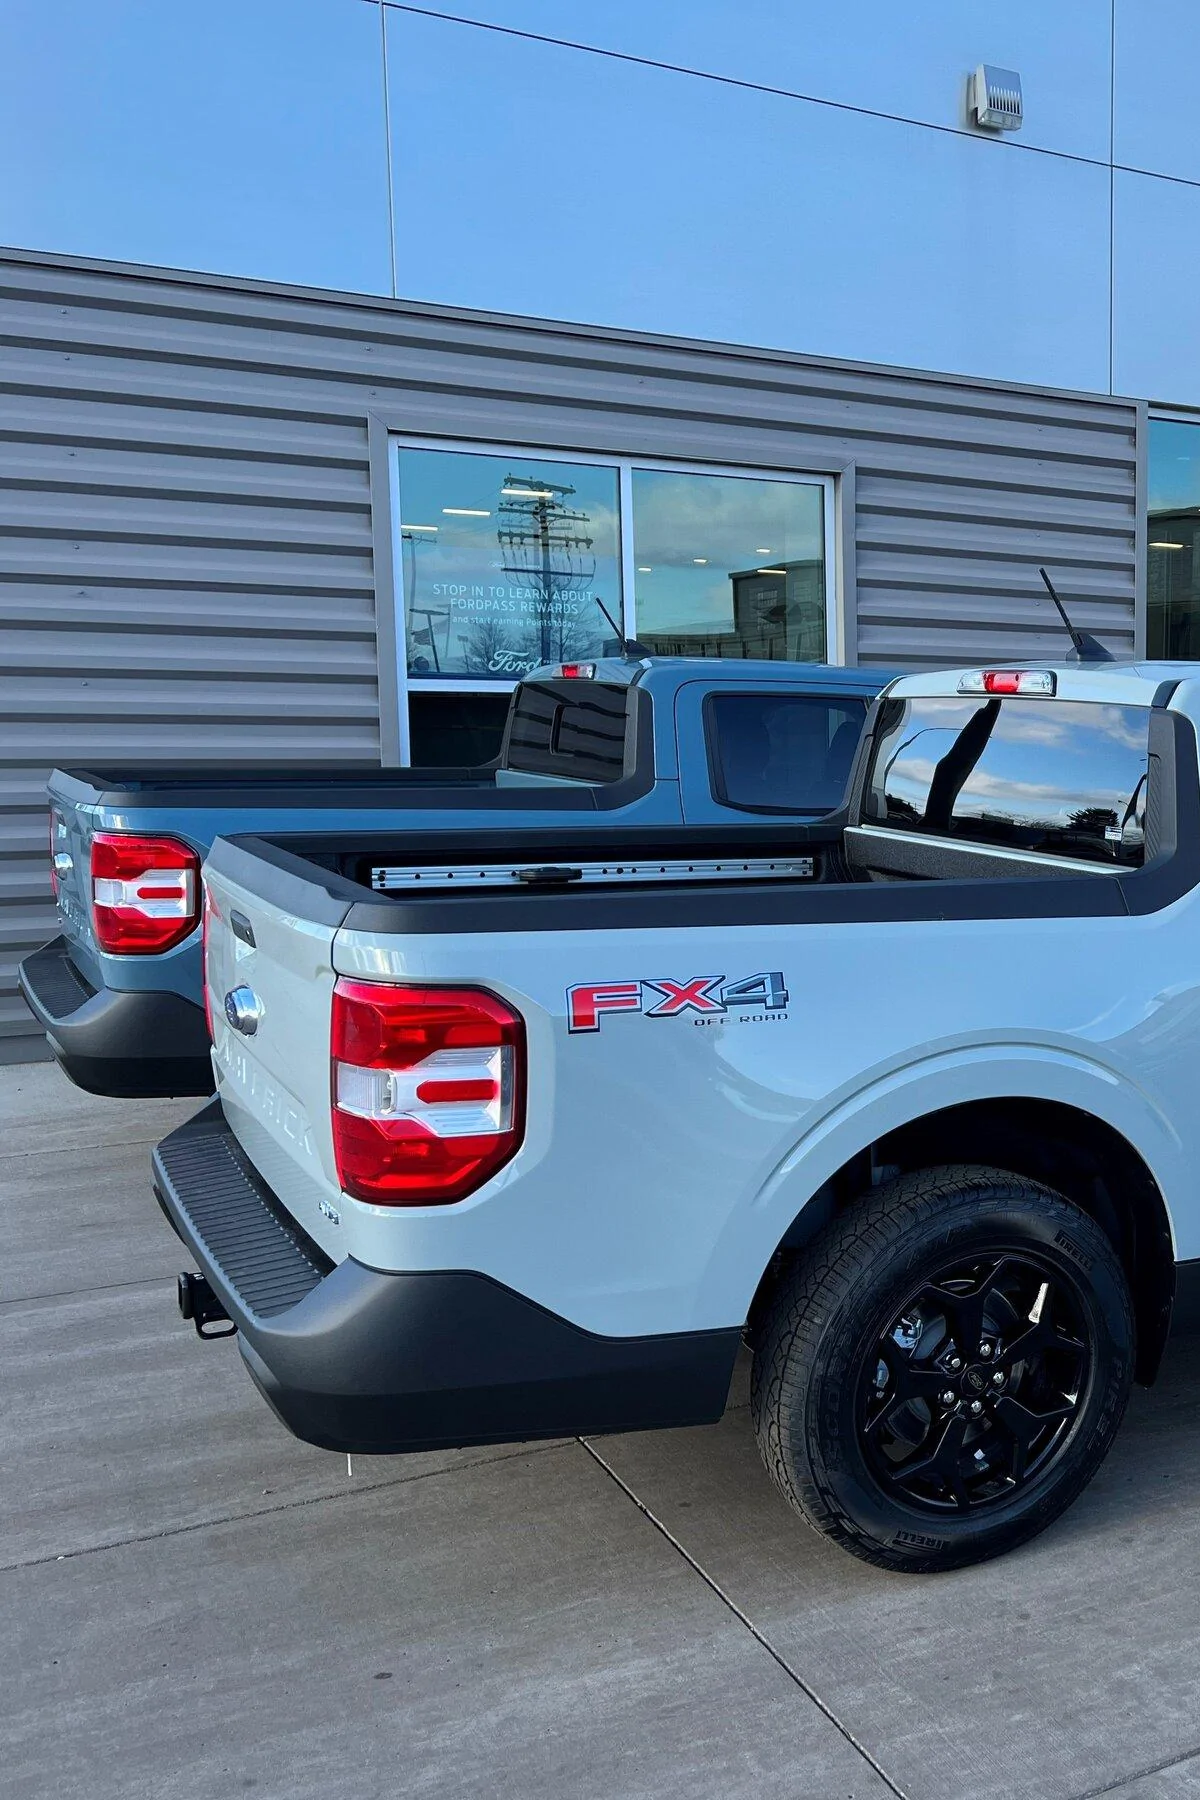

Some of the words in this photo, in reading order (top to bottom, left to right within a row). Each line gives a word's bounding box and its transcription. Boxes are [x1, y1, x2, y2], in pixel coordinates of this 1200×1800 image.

[433, 583, 467, 596] STOP
[471, 586, 484, 597] IN
[488, 586, 505, 598] TO
[509, 588, 549, 600] LEARN
[553, 590, 593, 602] ABOUT
[450, 598, 516, 612] FORDPASS
[520, 602, 579, 615] REWARDS
[452, 616, 469, 625] and
[471, 617, 490, 625] start
[488, 650, 543, 673] Ford
[566, 971, 789, 1035] FX4
[694, 1018, 730, 1027] OFF
[740, 1013, 788, 1023] ROAD
